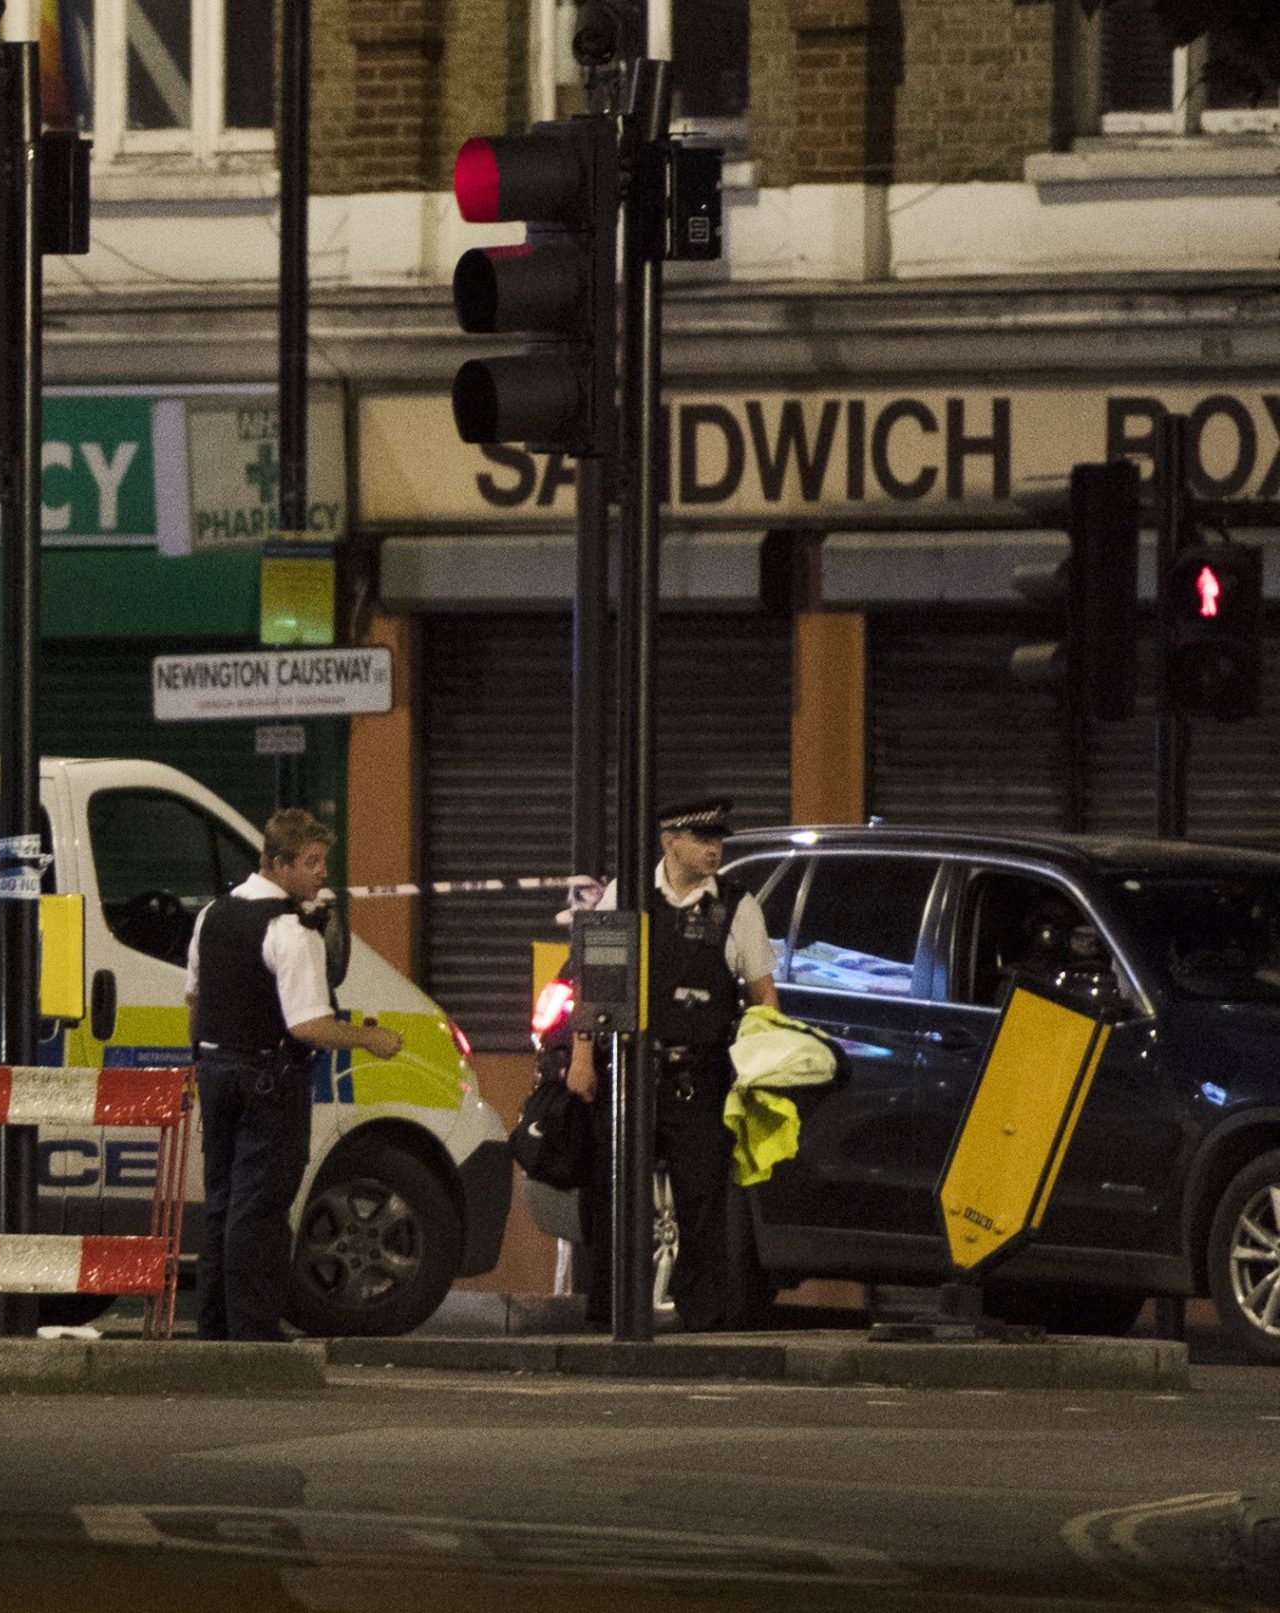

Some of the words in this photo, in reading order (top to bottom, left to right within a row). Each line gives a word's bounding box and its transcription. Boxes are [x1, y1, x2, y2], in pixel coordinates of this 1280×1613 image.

[476, 398, 1012, 507] SDWICH
[196, 501, 338, 539] PHARCY
[157, 659, 269, 690] NEWINGTON
[277, 656, 372, 686] CAUSEWAY
